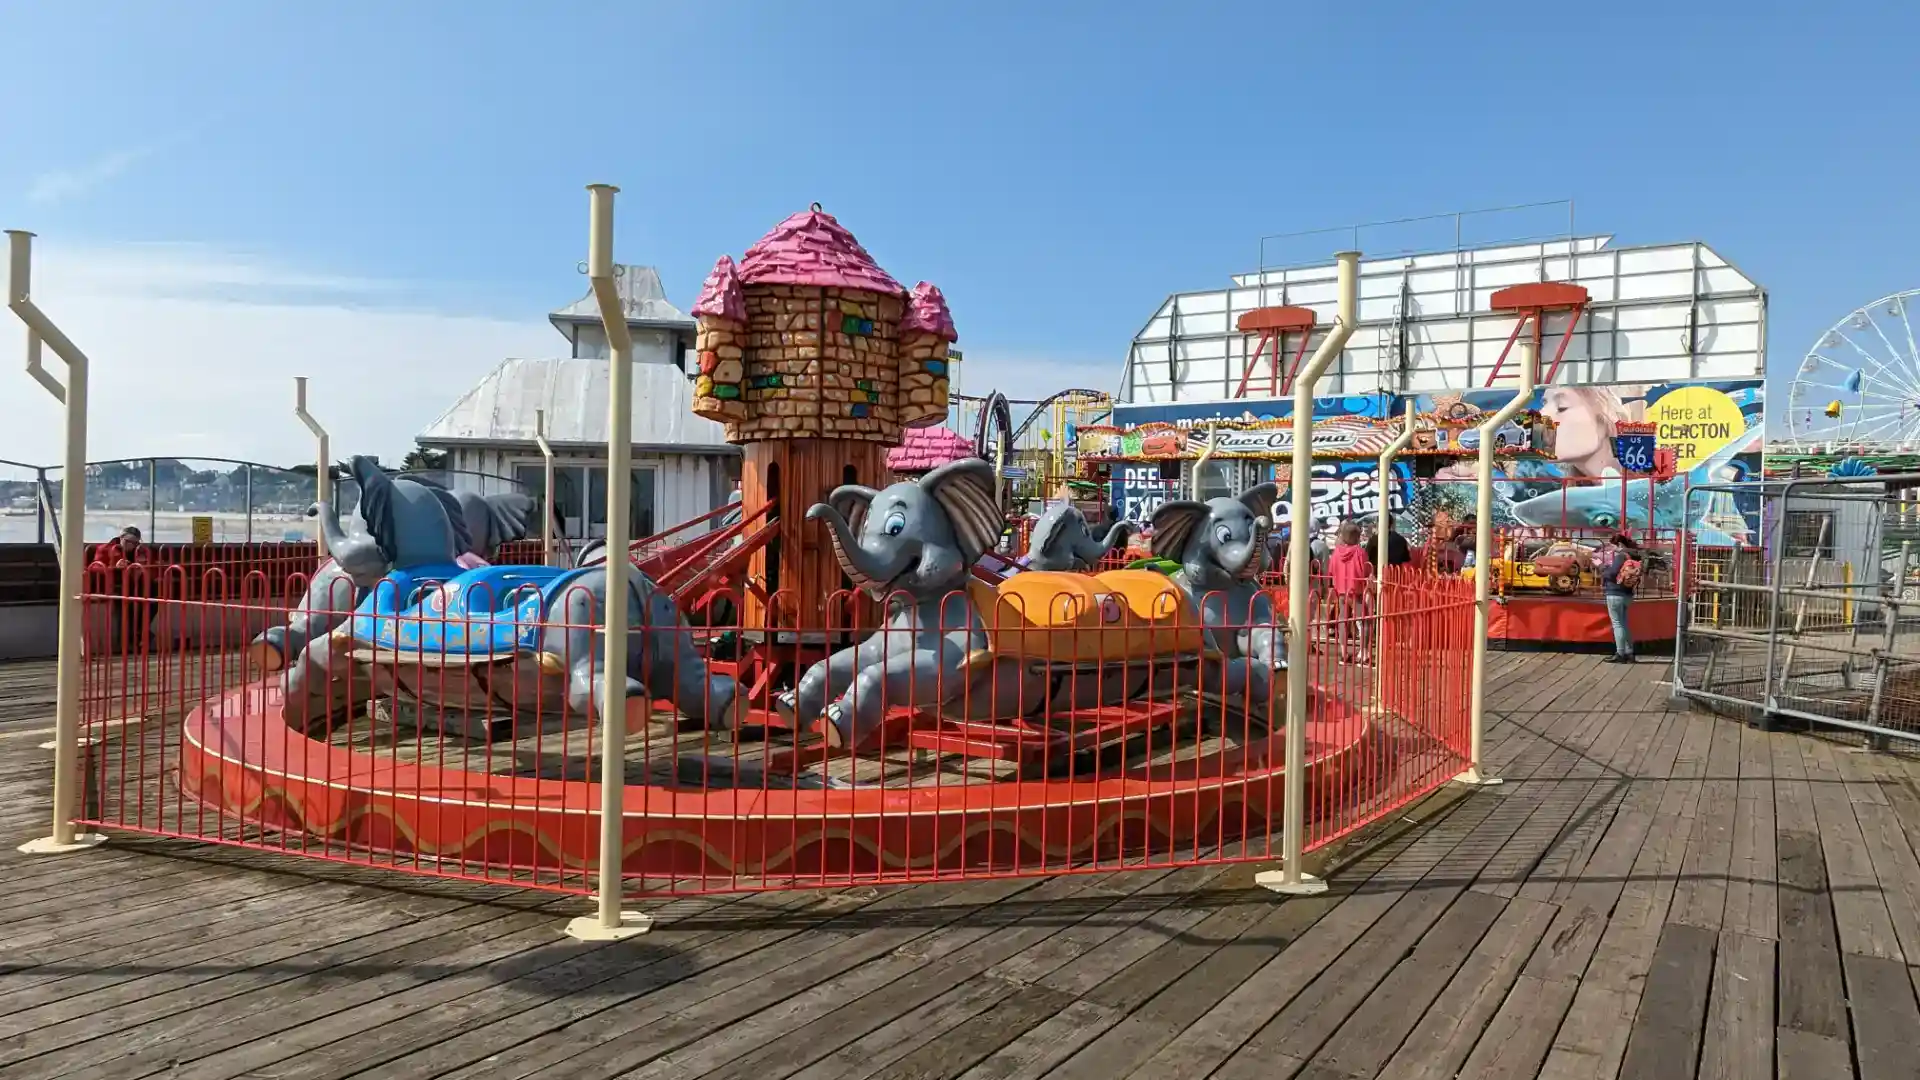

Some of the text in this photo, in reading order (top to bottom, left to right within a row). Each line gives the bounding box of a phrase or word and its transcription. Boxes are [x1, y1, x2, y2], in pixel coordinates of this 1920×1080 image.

[1660, 403, 1712, 420] Here at
[1660, 422, 1730, 439] CLACTON
[1630, 436, 1642, 444] US
[1625, 445, 1647, 466] 66
[1660, 443, 1696, 459] ER
